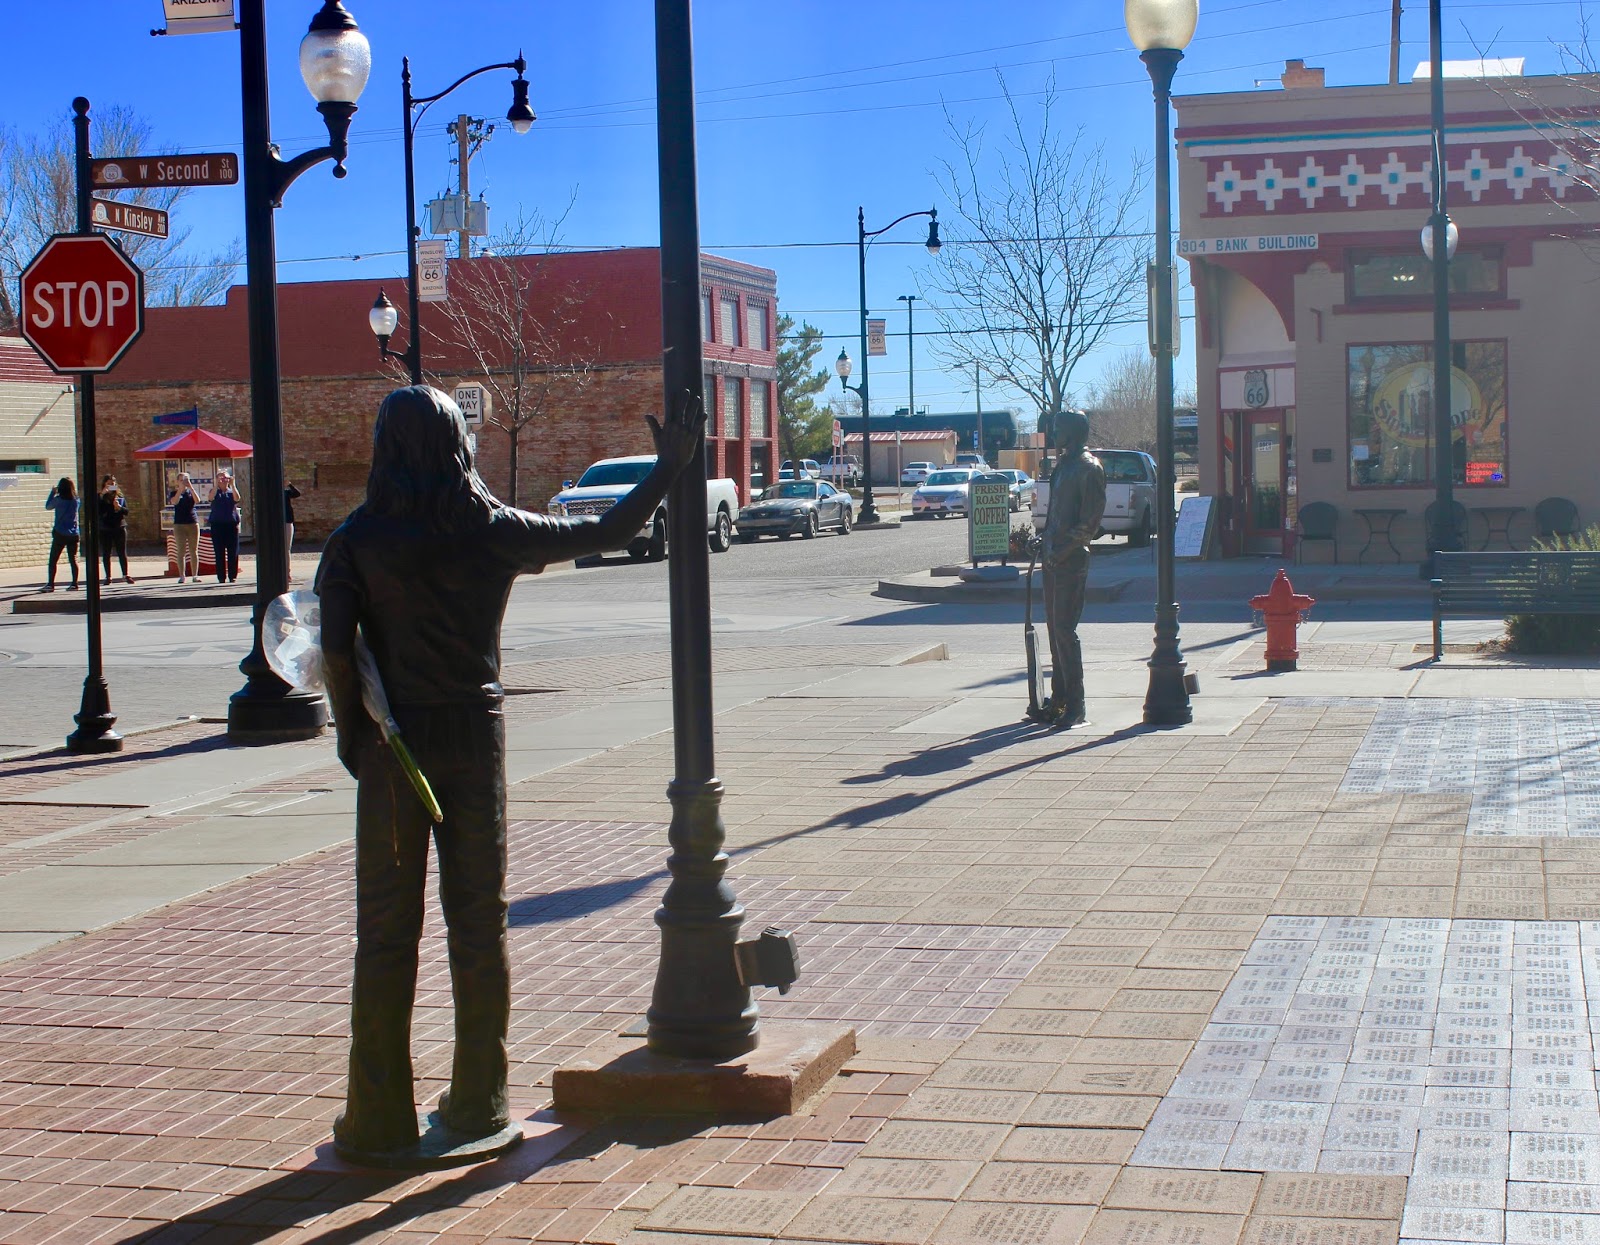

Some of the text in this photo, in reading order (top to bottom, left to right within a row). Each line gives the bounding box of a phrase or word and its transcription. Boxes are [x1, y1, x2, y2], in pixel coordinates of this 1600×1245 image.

[221, 158, 230, 169] St
[139, 160, 209, 181] W Second
[219, 168, 233, 180] 100
[115, 207, 153, 231] N Kinsley
[1177, 235, 1317, 253] 1904 BANK BUILDING
[424, 269, 439, 280] 66
[31, 280, 130, 329] STOP
[458, 390, 478, 400] ONE
[1247, 387, 1264, 405] 66
[458, 401, 478, 410] WAY
[974, 484, 1007, 495] FRESH
[975, 494, 1006, 505] ROAST
[973, 506, 1007, 526] COFFEE
